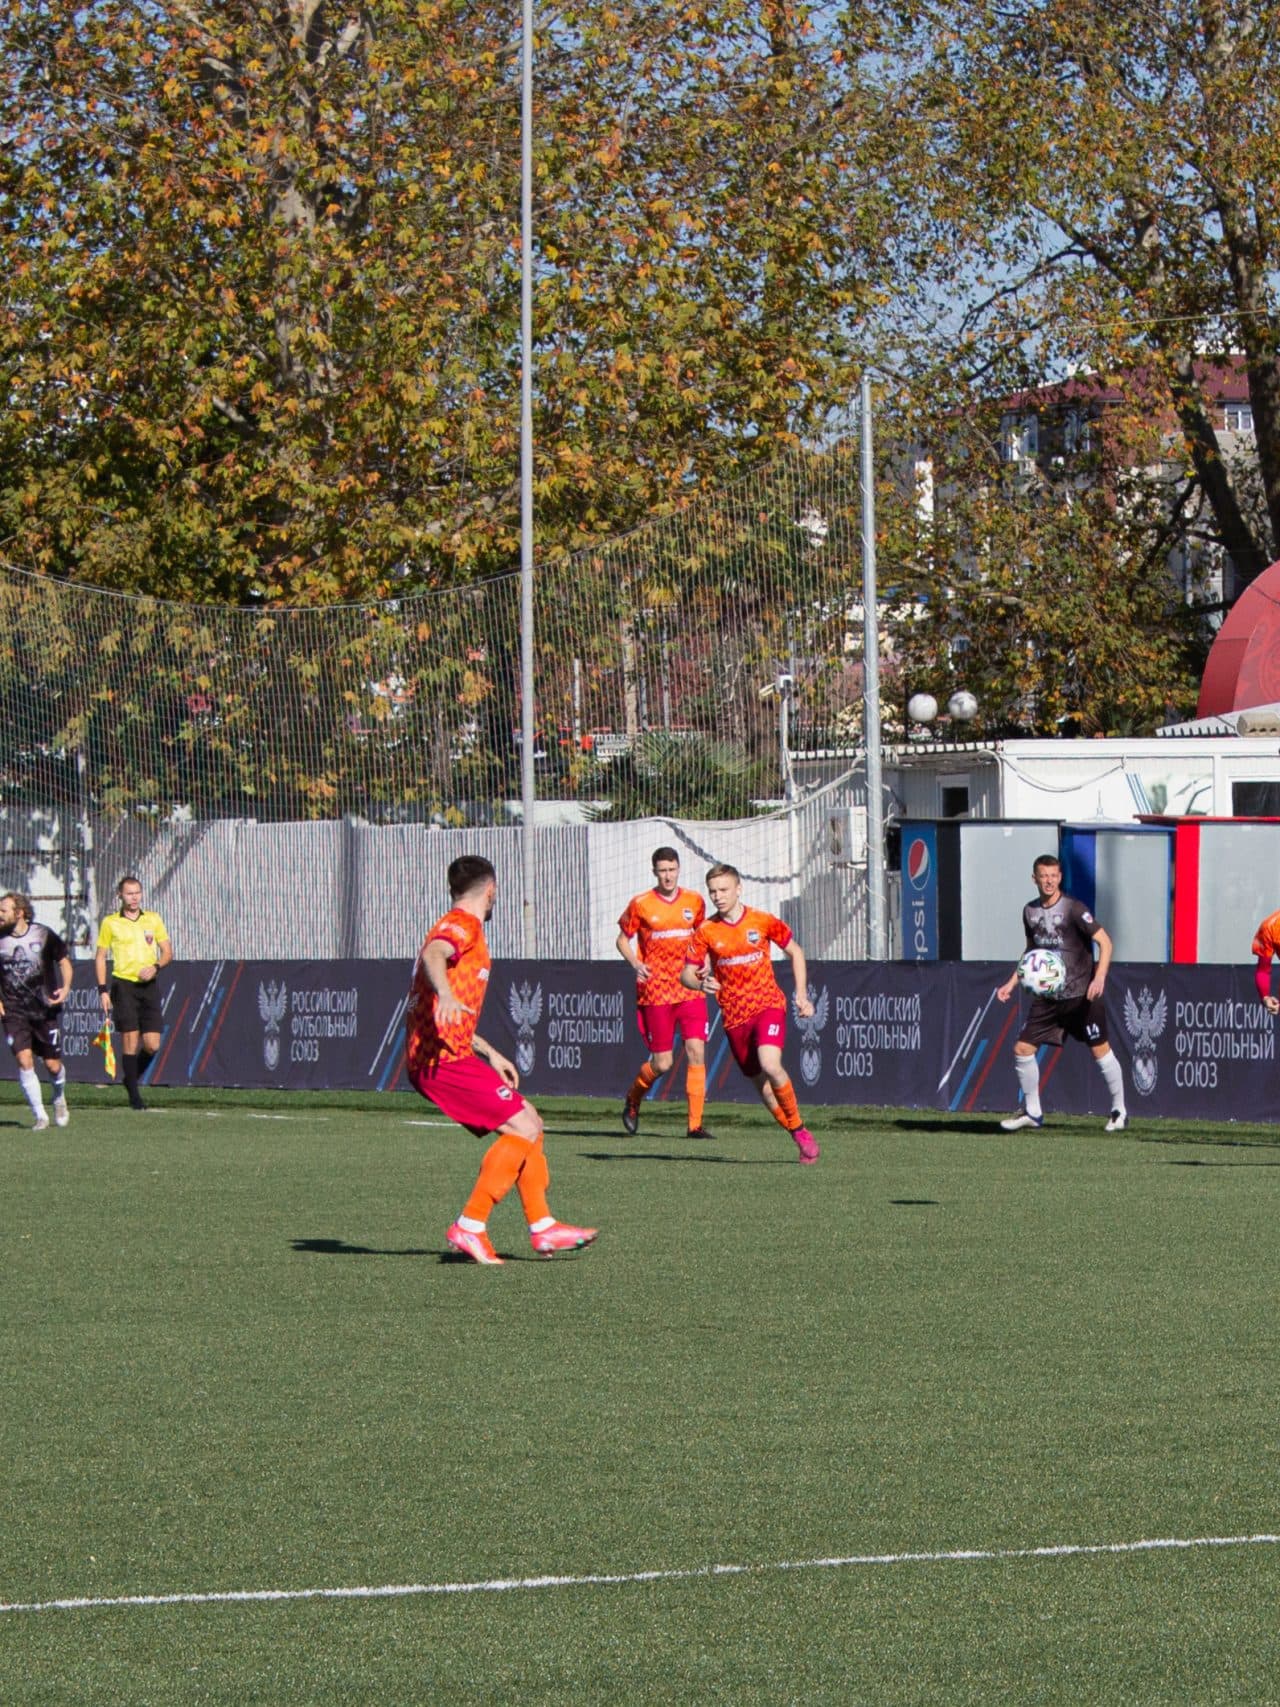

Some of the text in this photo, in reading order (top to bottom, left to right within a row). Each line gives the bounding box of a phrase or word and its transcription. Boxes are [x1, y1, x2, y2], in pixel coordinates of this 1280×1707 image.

[291, 988, 358, 1012] РОССИЙСКИЙ
[548, 990, 624, 1016] РОССИЙСКИЙ
[836, 993, 921, 1021] РОССИЙСКИЙ
[291, 1013, 358, 1037] ФУТБОЛЬНЫЙ
[548, 1018, 624, 1043] ФУТБОЛЬНЫЙ
[836, 1022, 921, 1050] ФУТБОЛЬНЫЙ
[62, 1036, 89, 1056] СОЮЗ
[291, 1039, 319, 1062] СОЮЗ
[548, 1045, 582, 1069] СОЮЗ
[1175, 1030, 1275, 1060] ФУТБОЛЬНЫЙ
[836, 1052, 874, 1077] СОЮЗ
[1175, 1061, 1218, 1088] СОЮЗ
